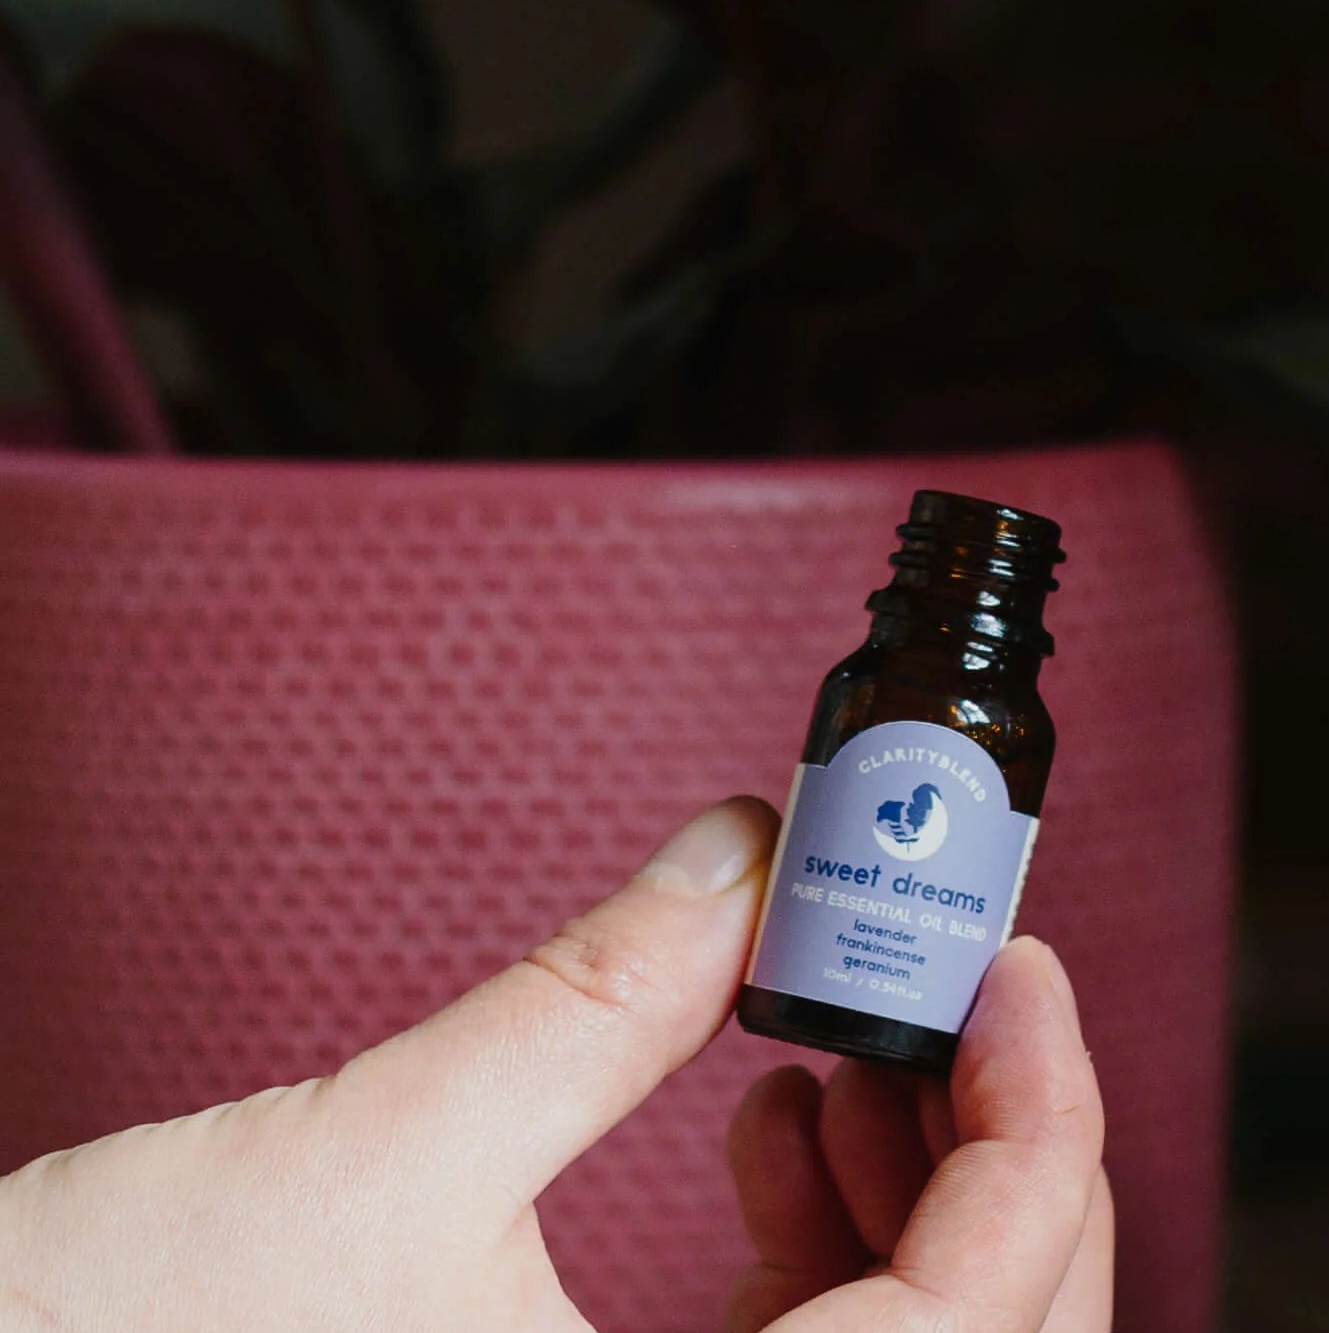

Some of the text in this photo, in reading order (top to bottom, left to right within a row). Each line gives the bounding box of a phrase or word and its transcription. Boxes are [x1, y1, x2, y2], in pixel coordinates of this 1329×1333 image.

[858, 747, 987, 803] CLARITYBLEND
[804, 854, 987, 914] sweet dreams
[791, 882, 987, 942] PURE ESSENTIAL OIL BLEND
[853, 918, 918, 945] lavender
[836, 932, 927, 966] frankincense
[842, 954, 911, 981] geranium
